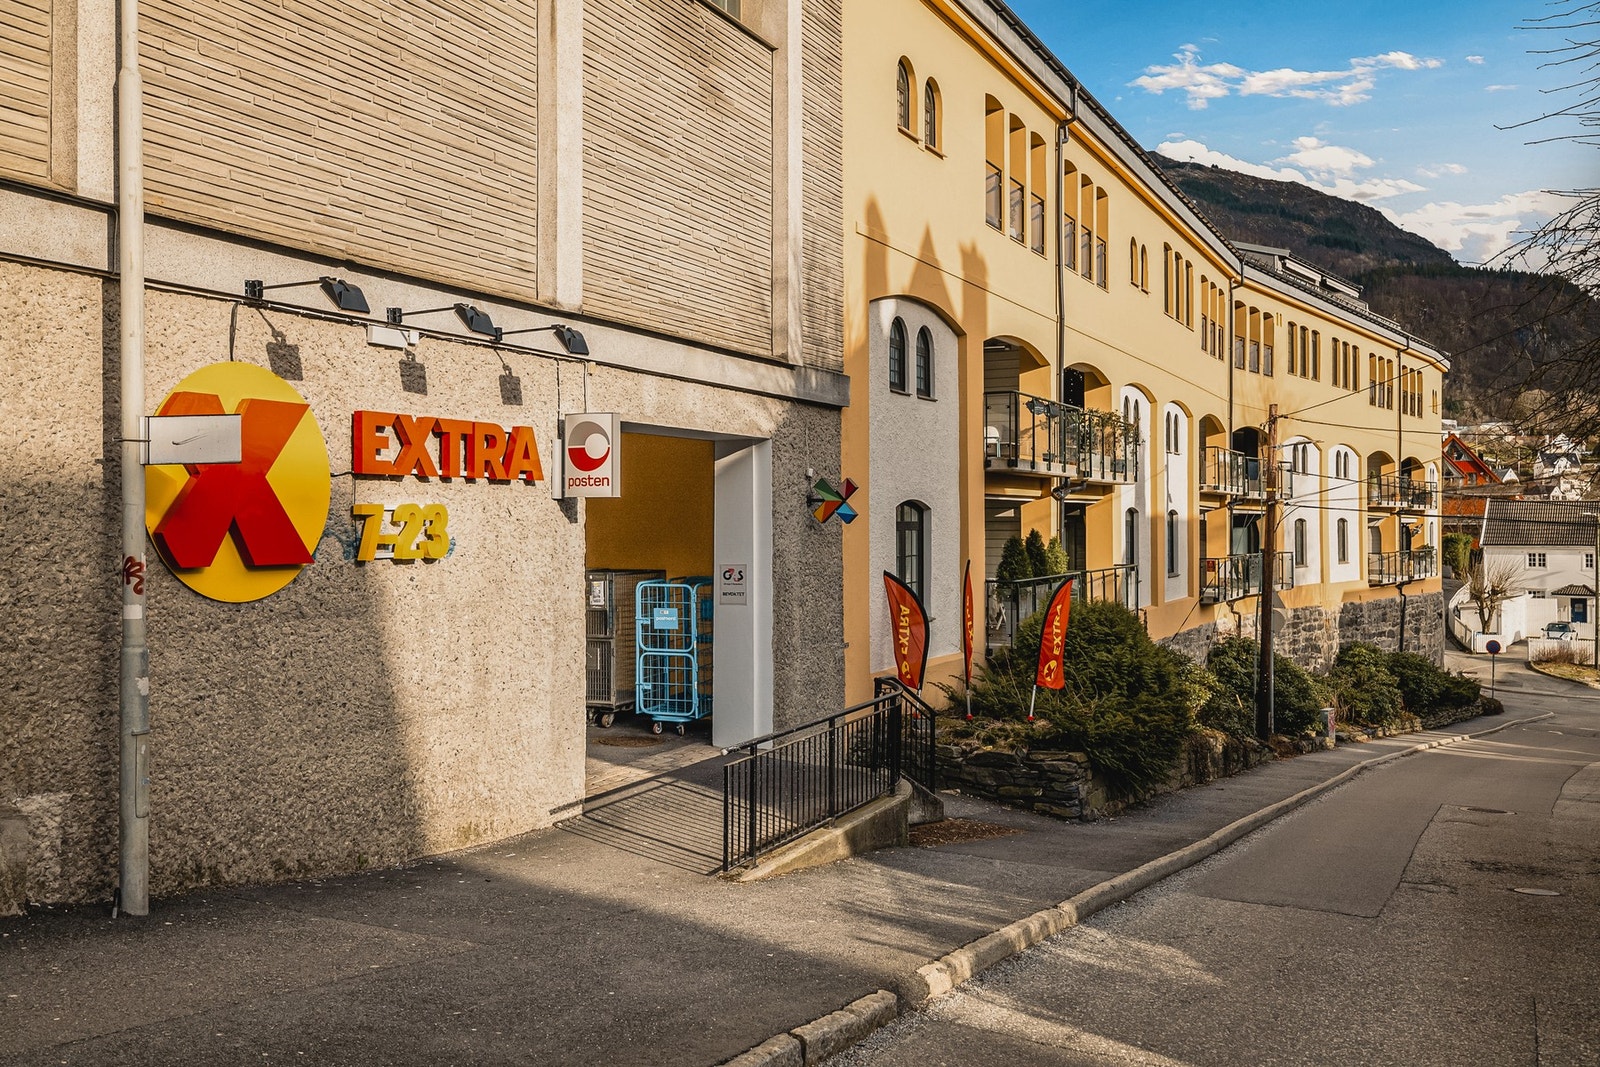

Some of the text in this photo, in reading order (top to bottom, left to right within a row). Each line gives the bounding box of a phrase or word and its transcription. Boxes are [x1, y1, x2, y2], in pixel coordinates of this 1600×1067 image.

[353, 410, 545, 481] EXTRA
[567, 474, 610, 489] posten
[353, 503, 449, 562] 7-23
[1052, 604, 1062, 656] EXTRA
